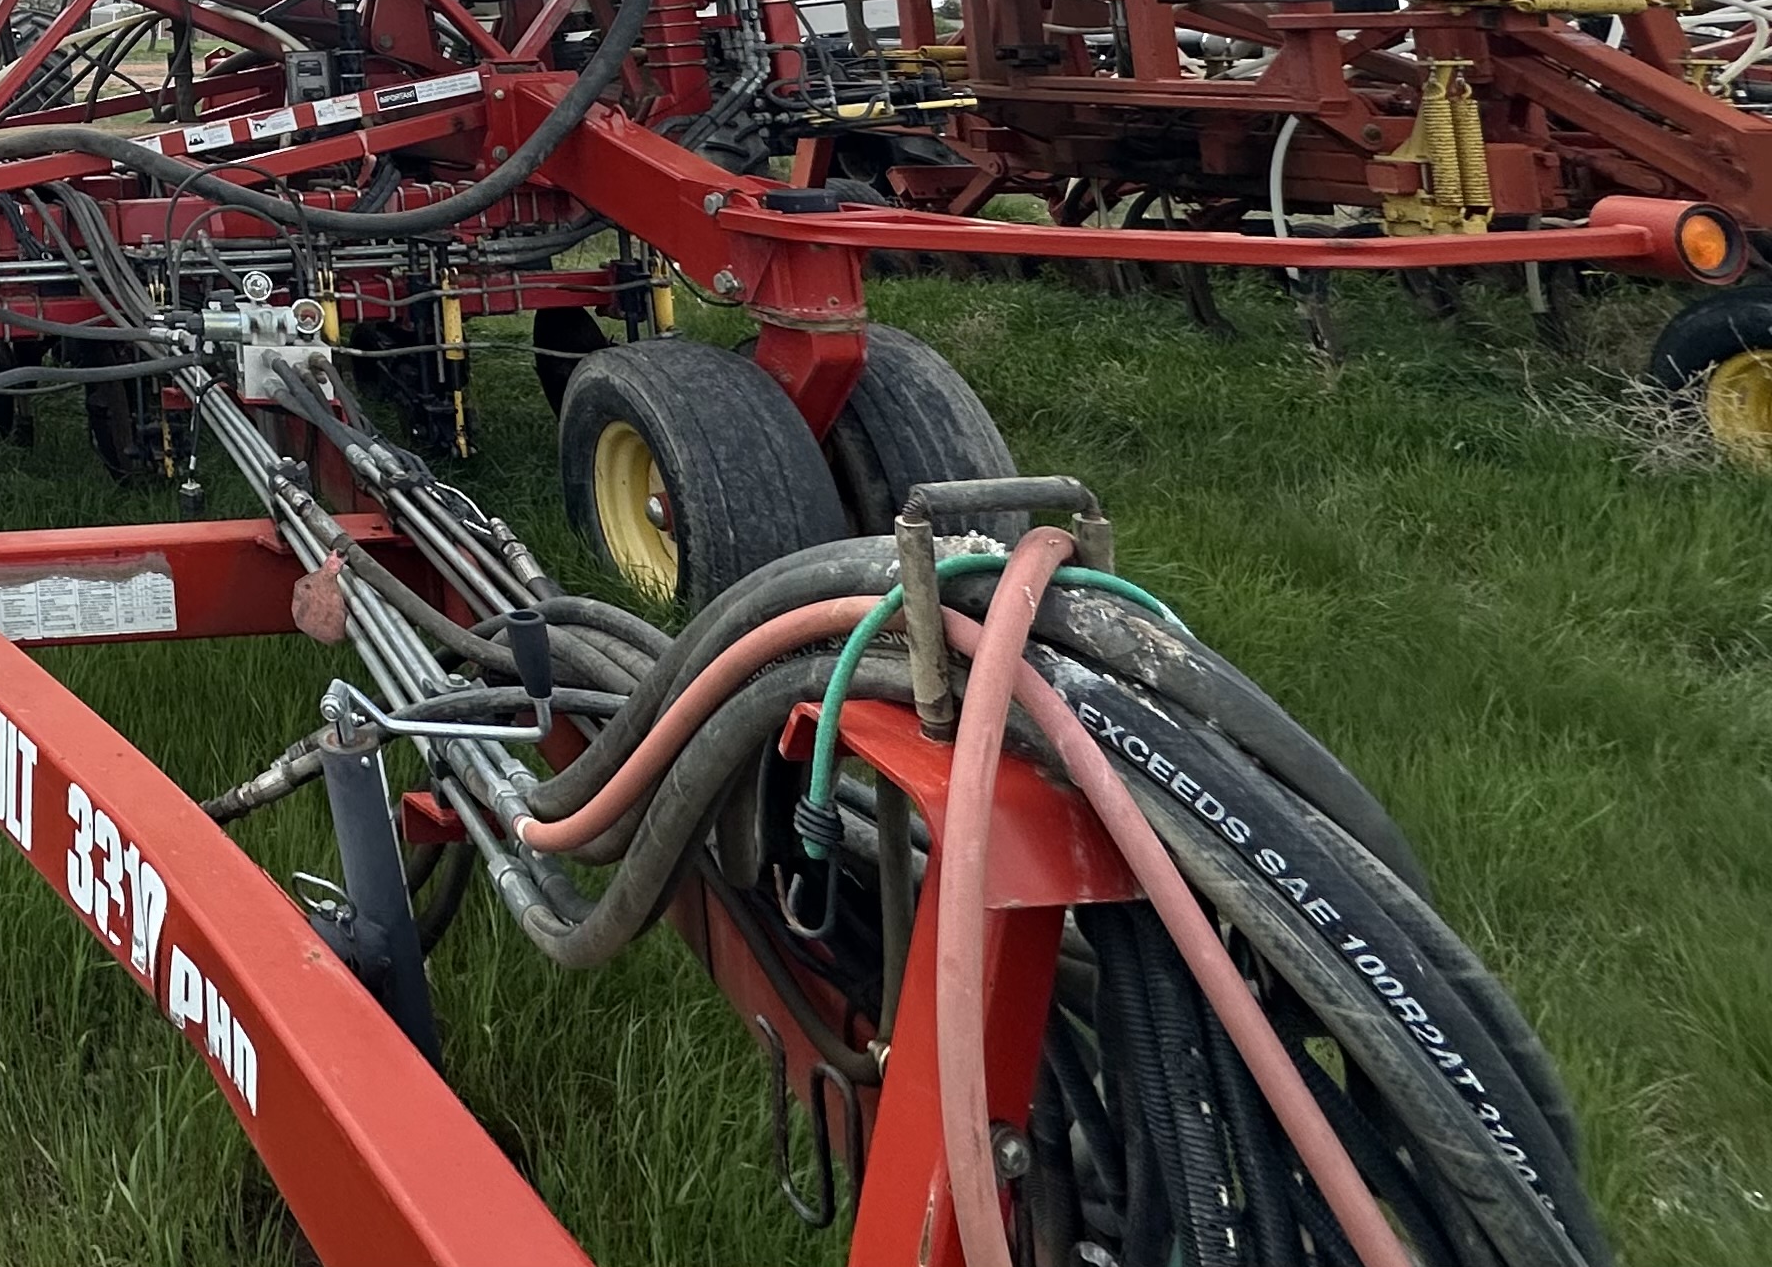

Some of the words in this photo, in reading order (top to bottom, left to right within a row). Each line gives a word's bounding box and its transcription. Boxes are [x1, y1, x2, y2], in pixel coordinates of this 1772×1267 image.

[1077, 702, 1251, 845] EXCEEDS
[1254, 848, 1341, 926] SAE
[1341, 933, 1485, 1093] 100R2AT
